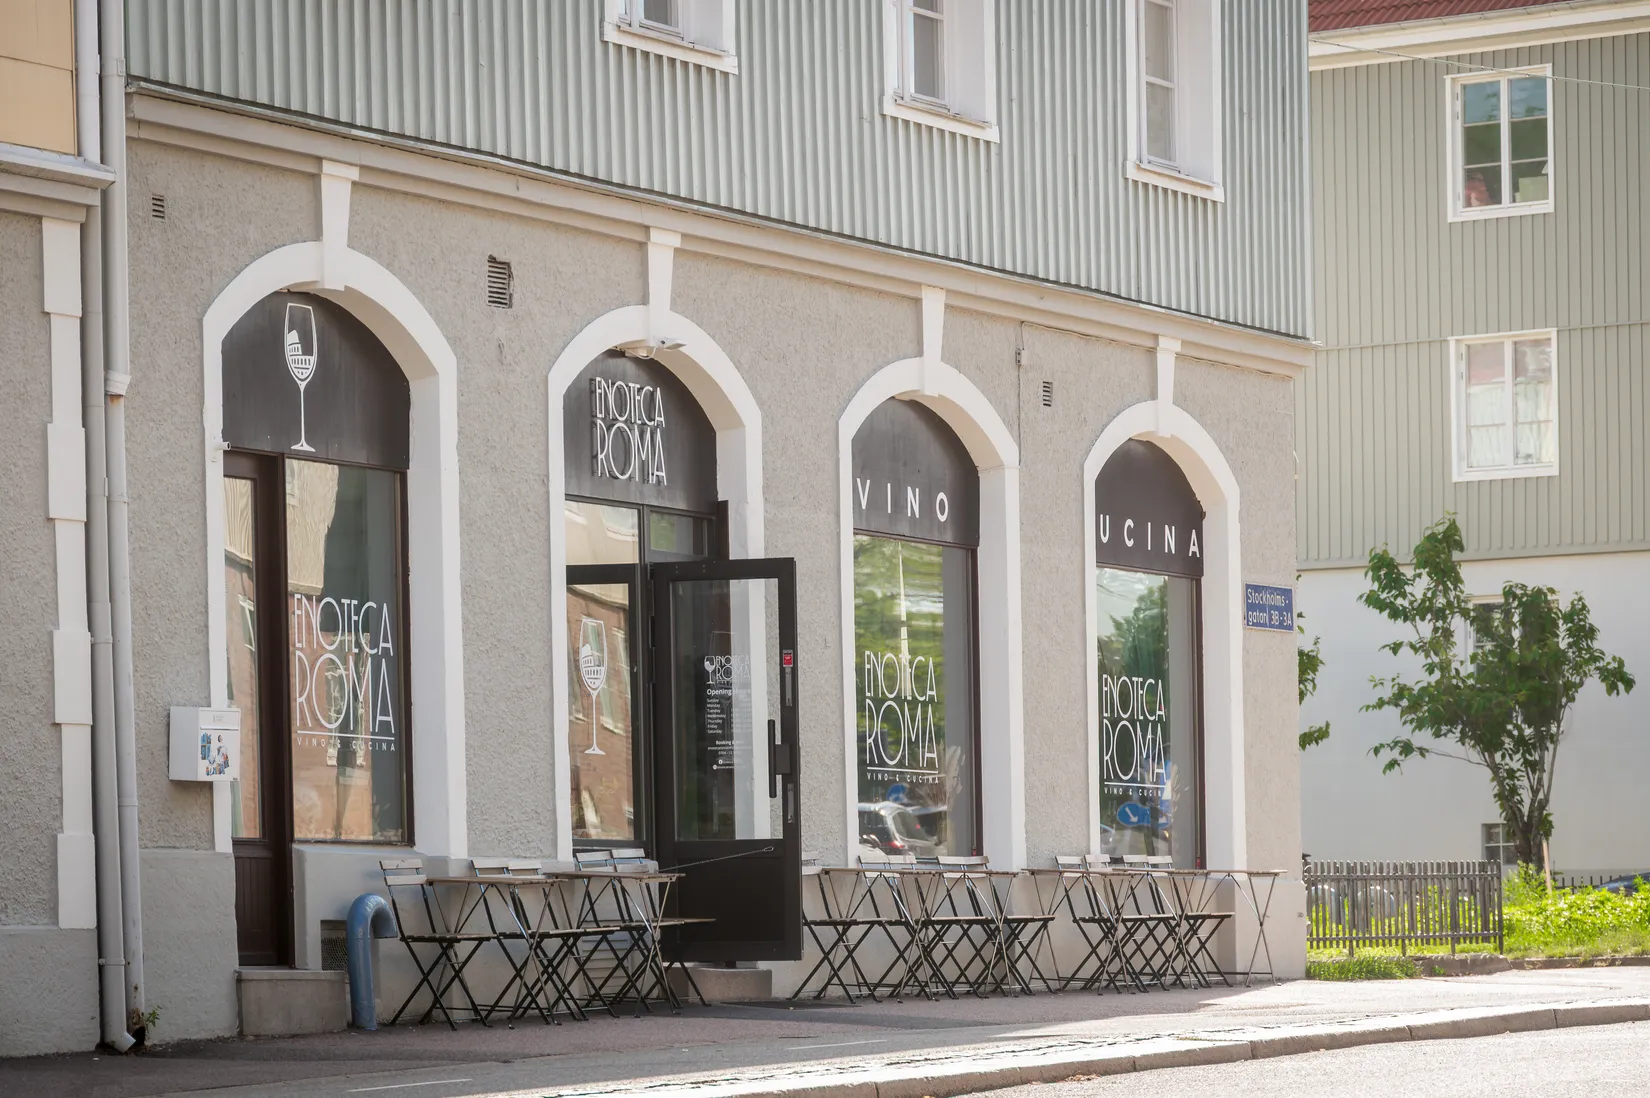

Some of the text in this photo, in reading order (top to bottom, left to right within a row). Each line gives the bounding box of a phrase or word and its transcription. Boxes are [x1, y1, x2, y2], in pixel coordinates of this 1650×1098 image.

[596, 377, 665, 427] ENOTECA
[597, 420, 667, 485] ROMA
[857, 478, 948, 522] VINO
[1100, 514, 1200, 557] UCINA
[294, 594, 393, 656] ENOTECA
[296, 651, 395, 733] ROMA
[706, 688, 732, 696] Opening
[716, 665, 751, 680] ROMA
[865, 651, 937, 702] ENOTECA
[1103, 674, 1165, 721] ENOTECA
[297, 737, 326, 747] VINO
[352, 741, 395, 751] CUCINA
[866, 699, 938, 768] ROMA
[1104, 719, 1166, 782] ROMA
[867, 772, 888, 781] VINO
[906, 774, 939, 784] CUCINA
[1104, 787, 1123, 796] VINO
[1138, 788, 1163, 797] CUCIN
